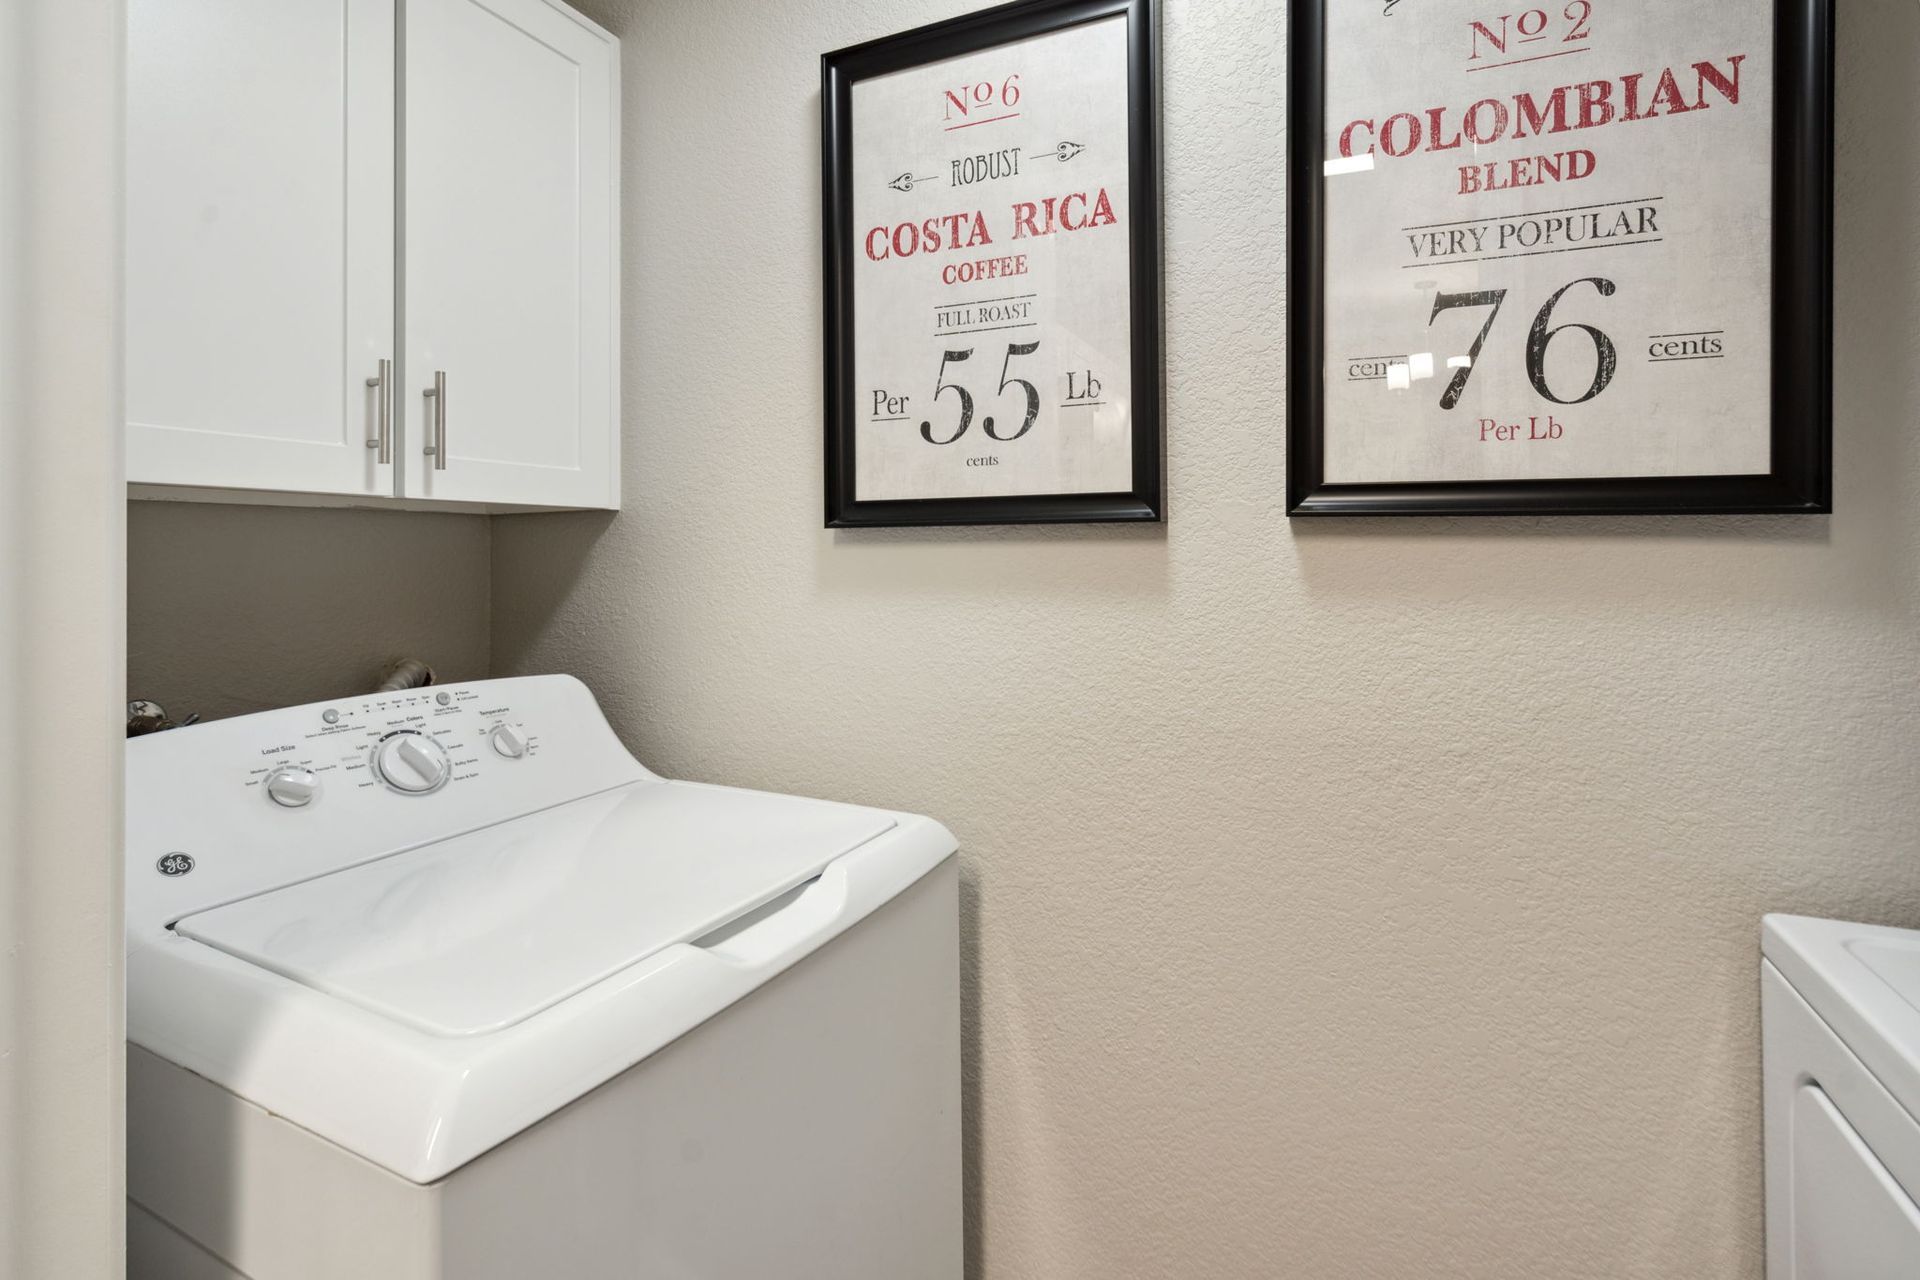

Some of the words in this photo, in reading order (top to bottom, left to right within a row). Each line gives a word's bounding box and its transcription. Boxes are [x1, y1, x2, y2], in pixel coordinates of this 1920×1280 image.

[1562, 0, 1592, 43] 2
[1001, 74, 1021, 108] 6
[1339, 55, 1747, 159] COLOMBIAN
[950, 147, 1021, 187] ROBUST
[1457, 148, 1597, 195] BLEND
[865, 210, 993, 262] COSTA
[1011, 187, 1118, 241] RICA
[1406, 225, 1489, 259] VERY
[1499, 206, 1660, 251] POPULAR
[942, 254, 1029, 285] COFFEE
[936, 310, 976, 329] FULL
[978, 302, 1033, 324] ROAST
[1428, 276, 1617, 411] 76
[1648, 334, 1724, 359] cents
[1348, 359, 1407, 377] cen
[920, 340, 1041, 445] 55
[1065, 369, 1102, 401] Lb
[872, 389, 910, 417] Per
[1478, 418, 1521, 442] Per
[1528, 415, 1564, 441] Lb
[966, 455, 1000, 468] cents
[261, 747, 280, 755] Load
[280, 744, 296, 752] Size
